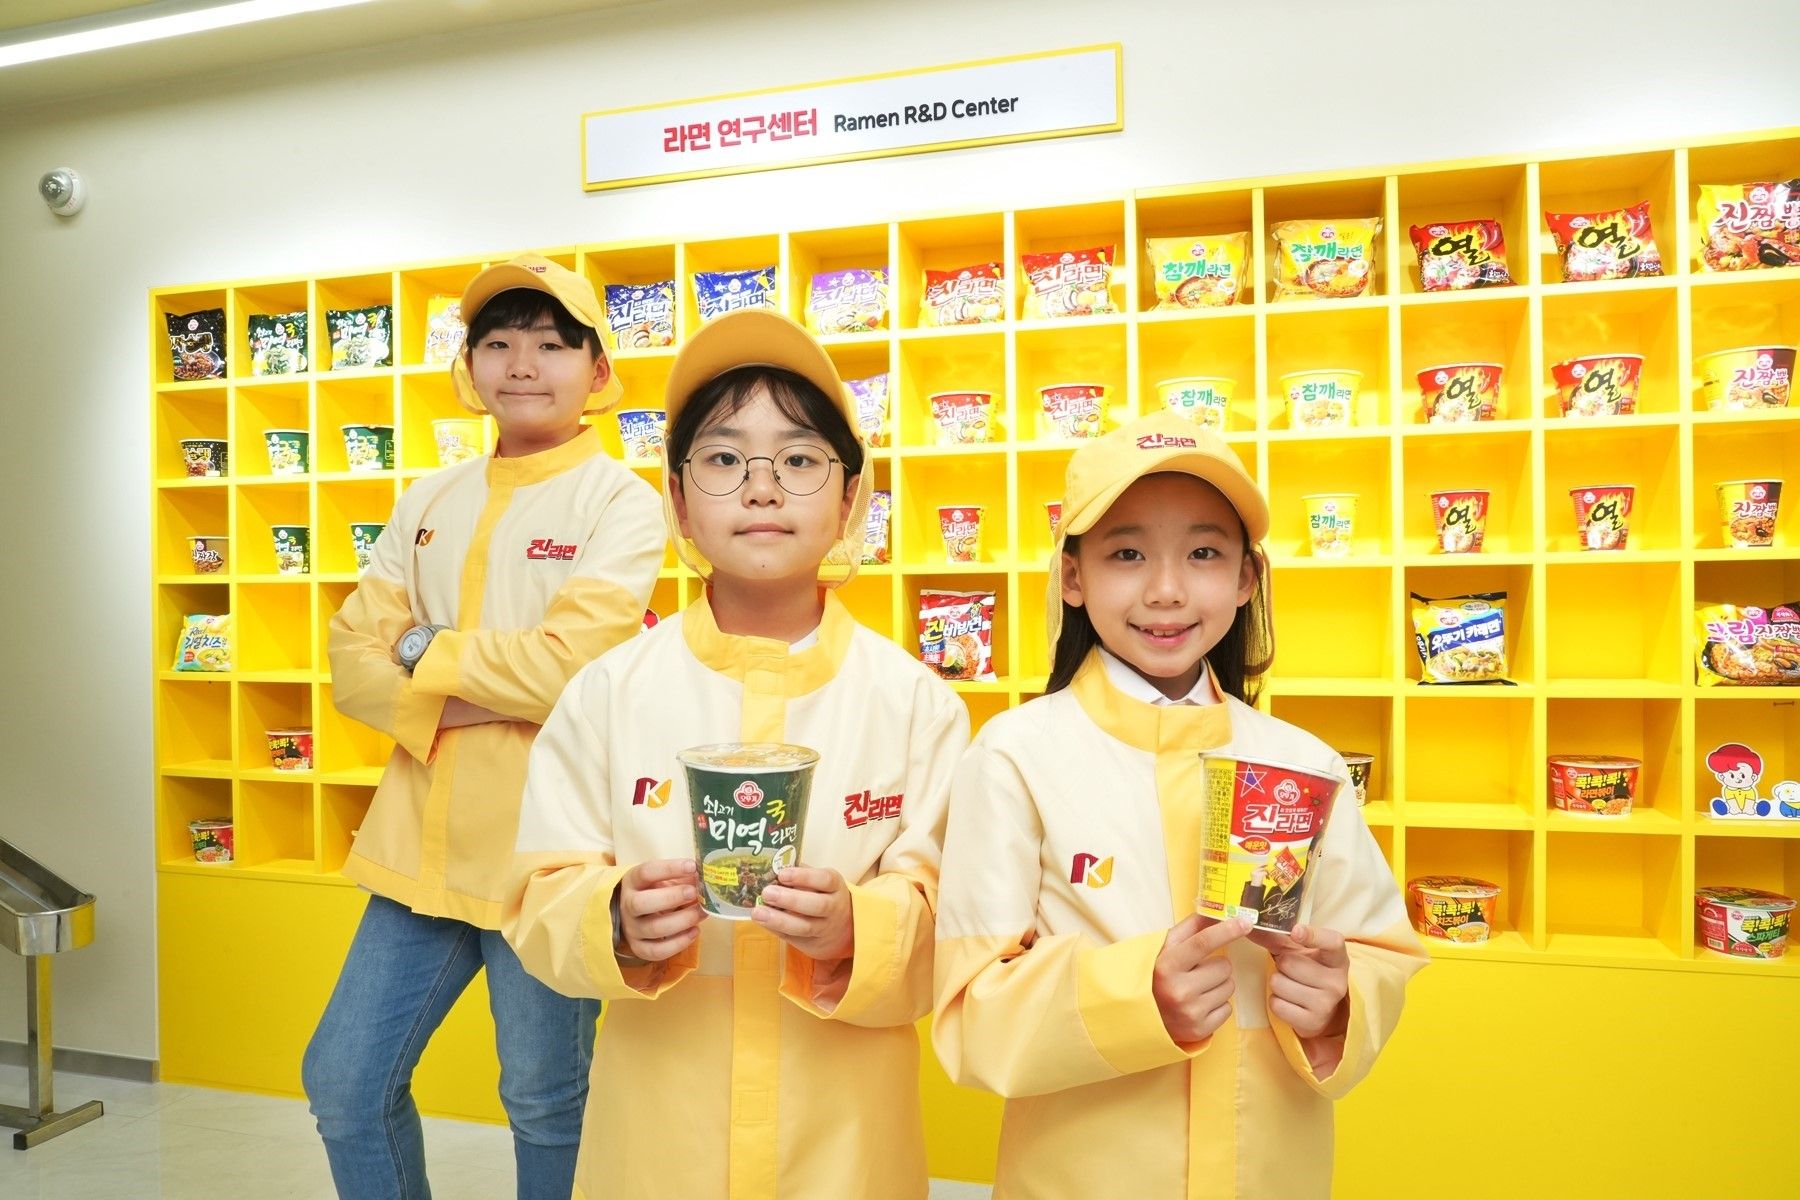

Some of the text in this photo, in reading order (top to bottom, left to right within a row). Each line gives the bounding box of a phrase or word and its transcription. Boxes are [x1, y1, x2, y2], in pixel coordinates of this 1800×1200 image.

[663, 108, 817, 152] 라면 연구센터
[834, 96, 1019, 132] Ramen R&D Center
[1432, 234, 1491, 266] 열
[1578, 222, 1641, 259] 열
[1302, 382, 1352, 401] 참깨라면
[1447, 376, 1482, 410] 열
[1584, 368, 1622, 403] 열
[1136, 434, 1197, 449] 진라면
[1446, 505, 1477, 534] 열
[1592, 501, 1624, 531] 열
[527, 539, 577, 560] 진라면
[766, 799, 786, 824] 국
[843, 790, 904, 829] 진라면
[1242, 804, 1314, 833] 진라면
[708, 817, 767, 855] 미역
[770, 824, 798, 844] 라면
